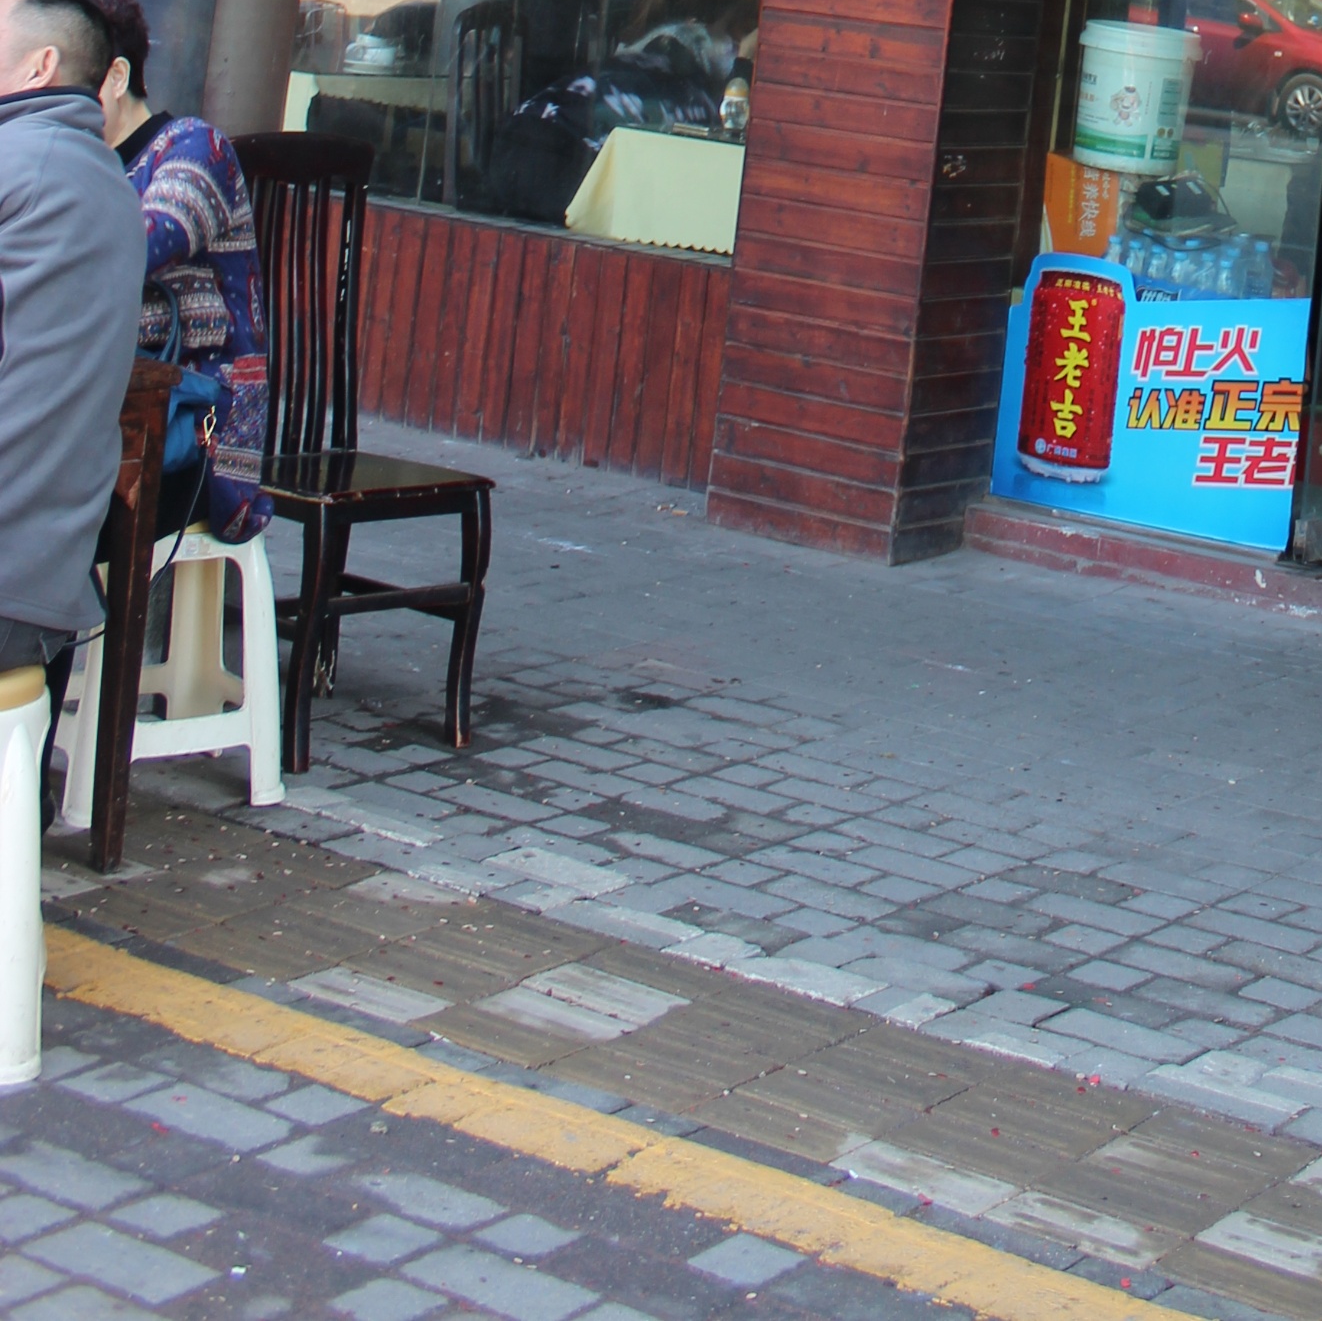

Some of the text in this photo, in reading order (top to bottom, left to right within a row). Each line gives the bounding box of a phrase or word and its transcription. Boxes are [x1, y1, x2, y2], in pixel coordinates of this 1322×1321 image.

[1049, 298, 1092, 440] 王老吉
[1131, 325, 1263, 381] 怕上火
[1126, 377, 1303, 432] 认准正宗
[1192, 435, 1298, 489] 王老
